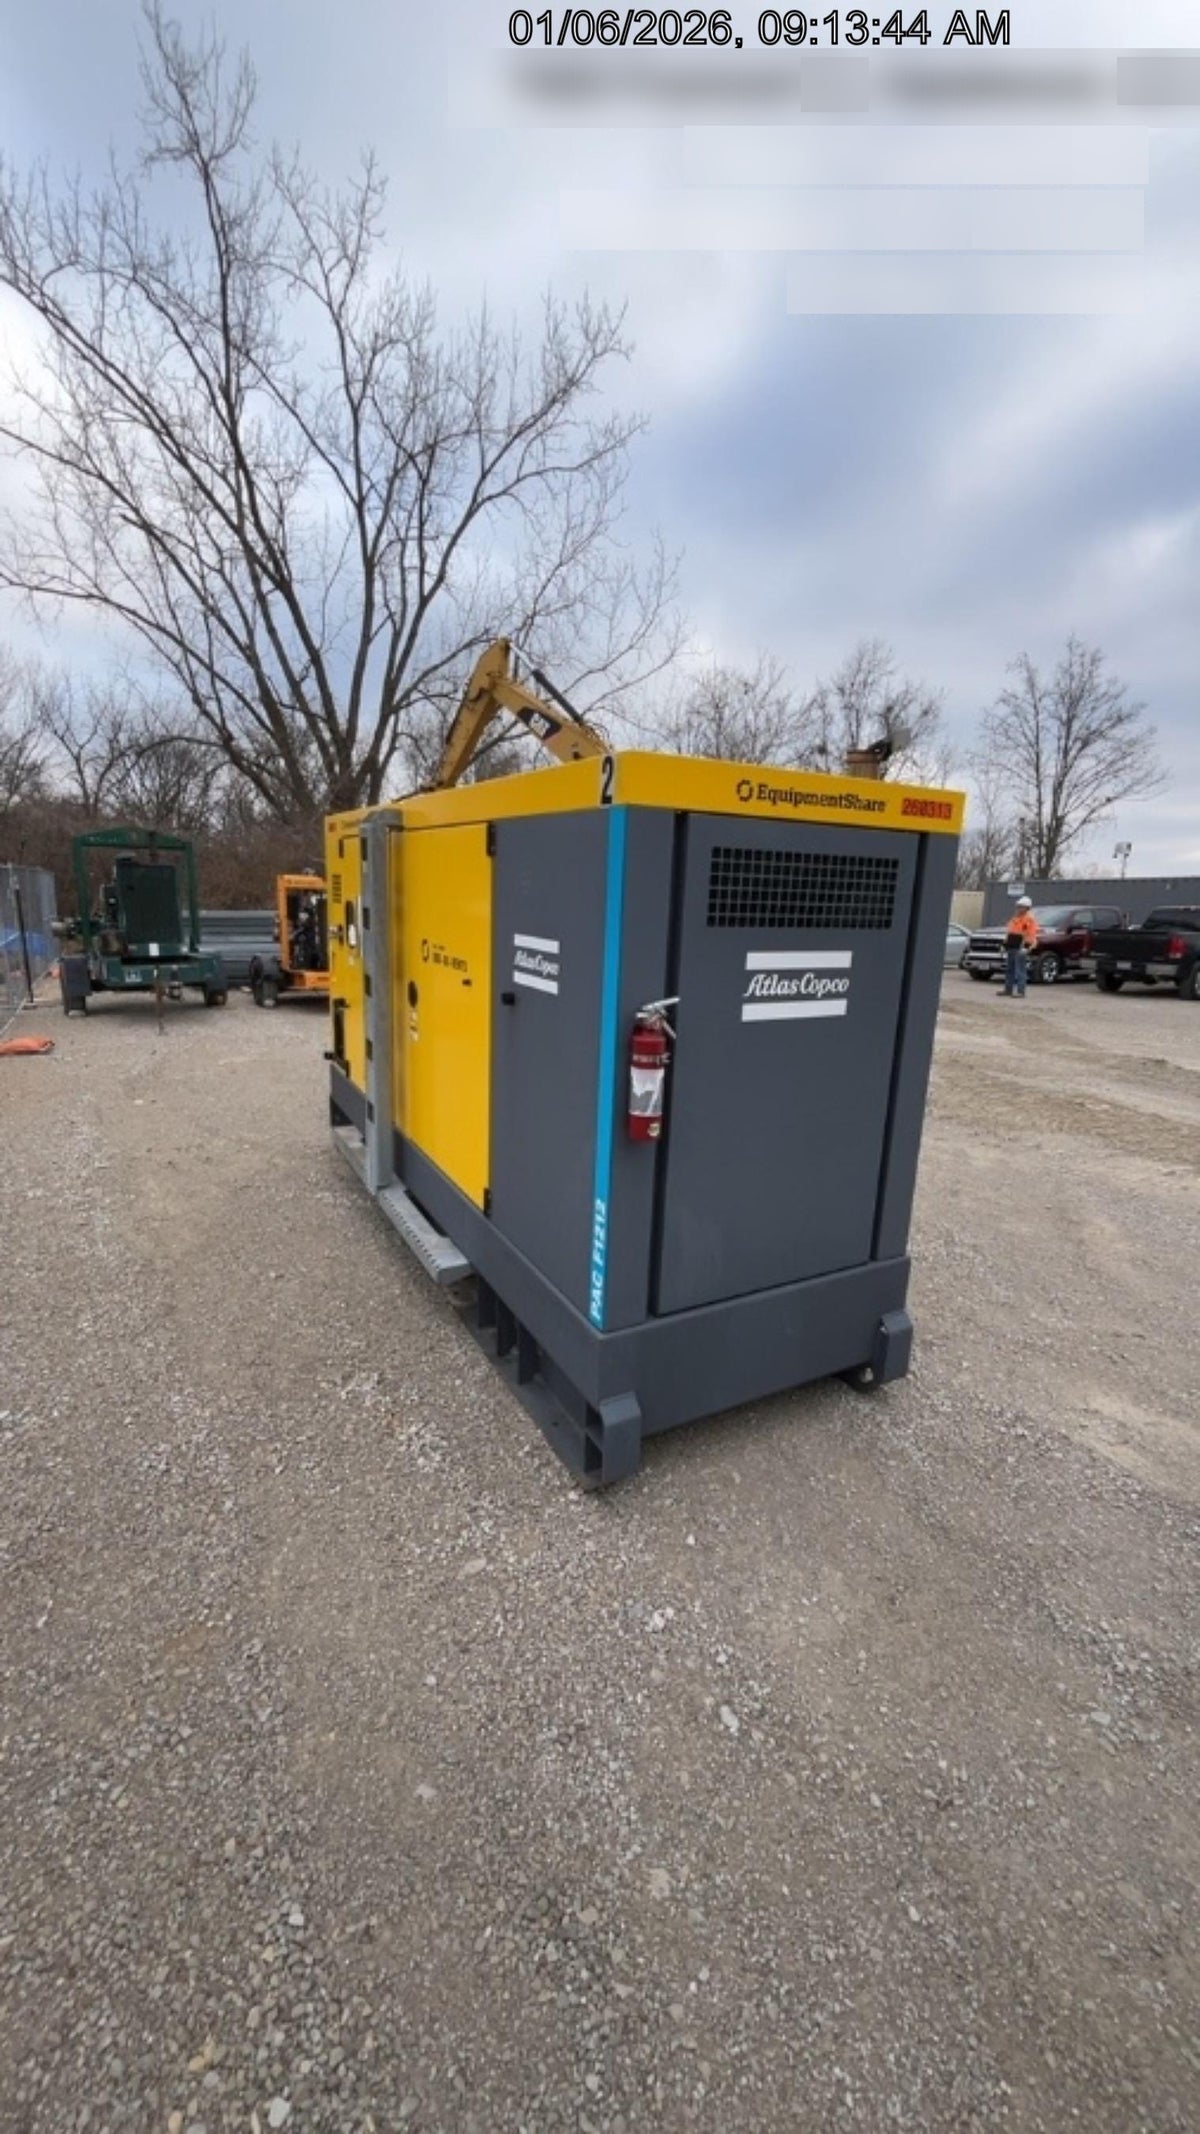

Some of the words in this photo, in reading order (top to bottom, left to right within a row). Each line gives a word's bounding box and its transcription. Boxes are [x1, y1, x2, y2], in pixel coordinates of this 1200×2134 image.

[601, 755, 613, 804] 2
[756, 783, 886, 813] EquipmentShare
[590, 1270, 603, 1320] PAC
